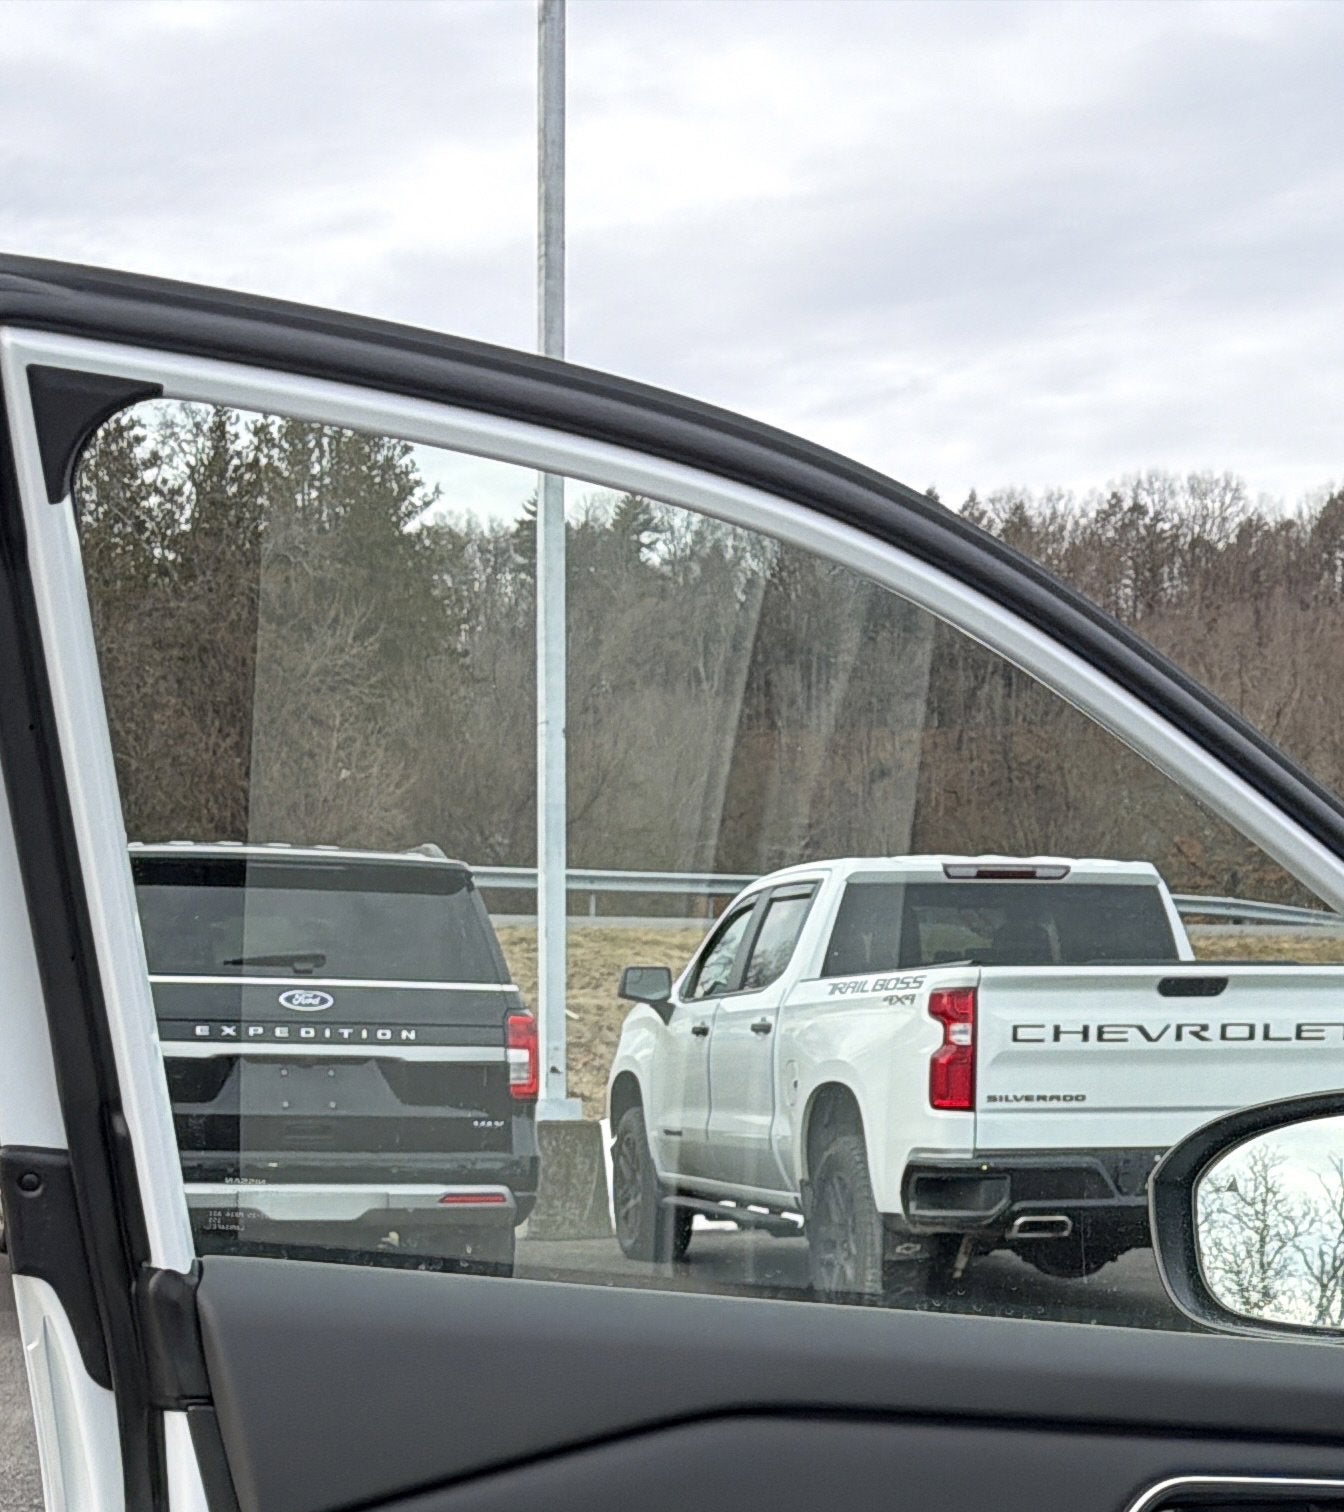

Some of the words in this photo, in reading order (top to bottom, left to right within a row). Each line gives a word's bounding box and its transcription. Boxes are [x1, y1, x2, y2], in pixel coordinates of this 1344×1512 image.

[828, 980, 869, 995] TRAIL
[870, 975, 927, 993] BOSS
[195, 1024, 417, 1041] EXPEDITION
[987, 1093, 1087, 1103] SILVERADO
